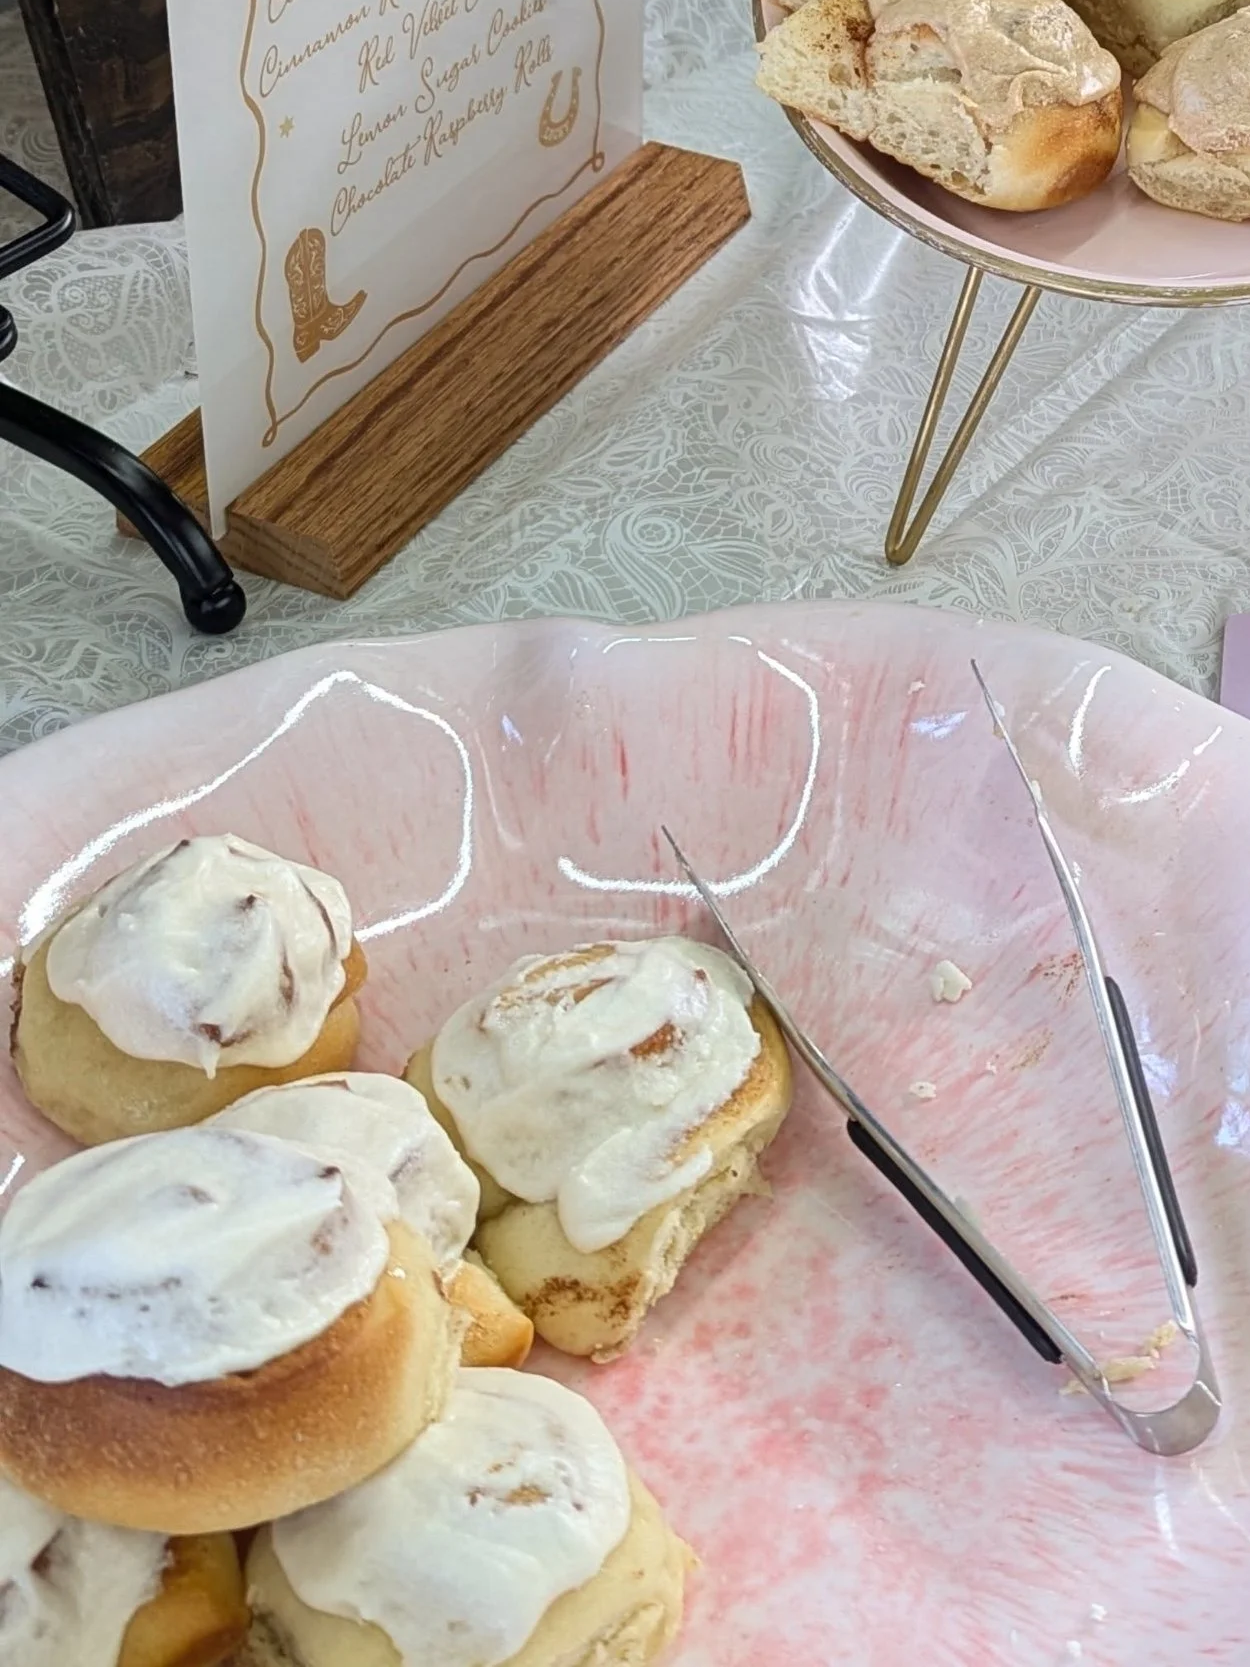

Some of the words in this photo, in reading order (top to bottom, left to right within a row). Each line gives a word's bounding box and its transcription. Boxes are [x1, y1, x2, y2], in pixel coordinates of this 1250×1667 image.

[260, 5, 370, 99] Cinnamon
[358, 35, 396, 94] Red
[331, 135, 422, 236] Chocolate
[424, 86, 508, 166] Raspberry
[515, 34, 553, 94] Rolls
[337, 104, 407, 175] Lemon
[415, 43, 481, 114] Sugar
